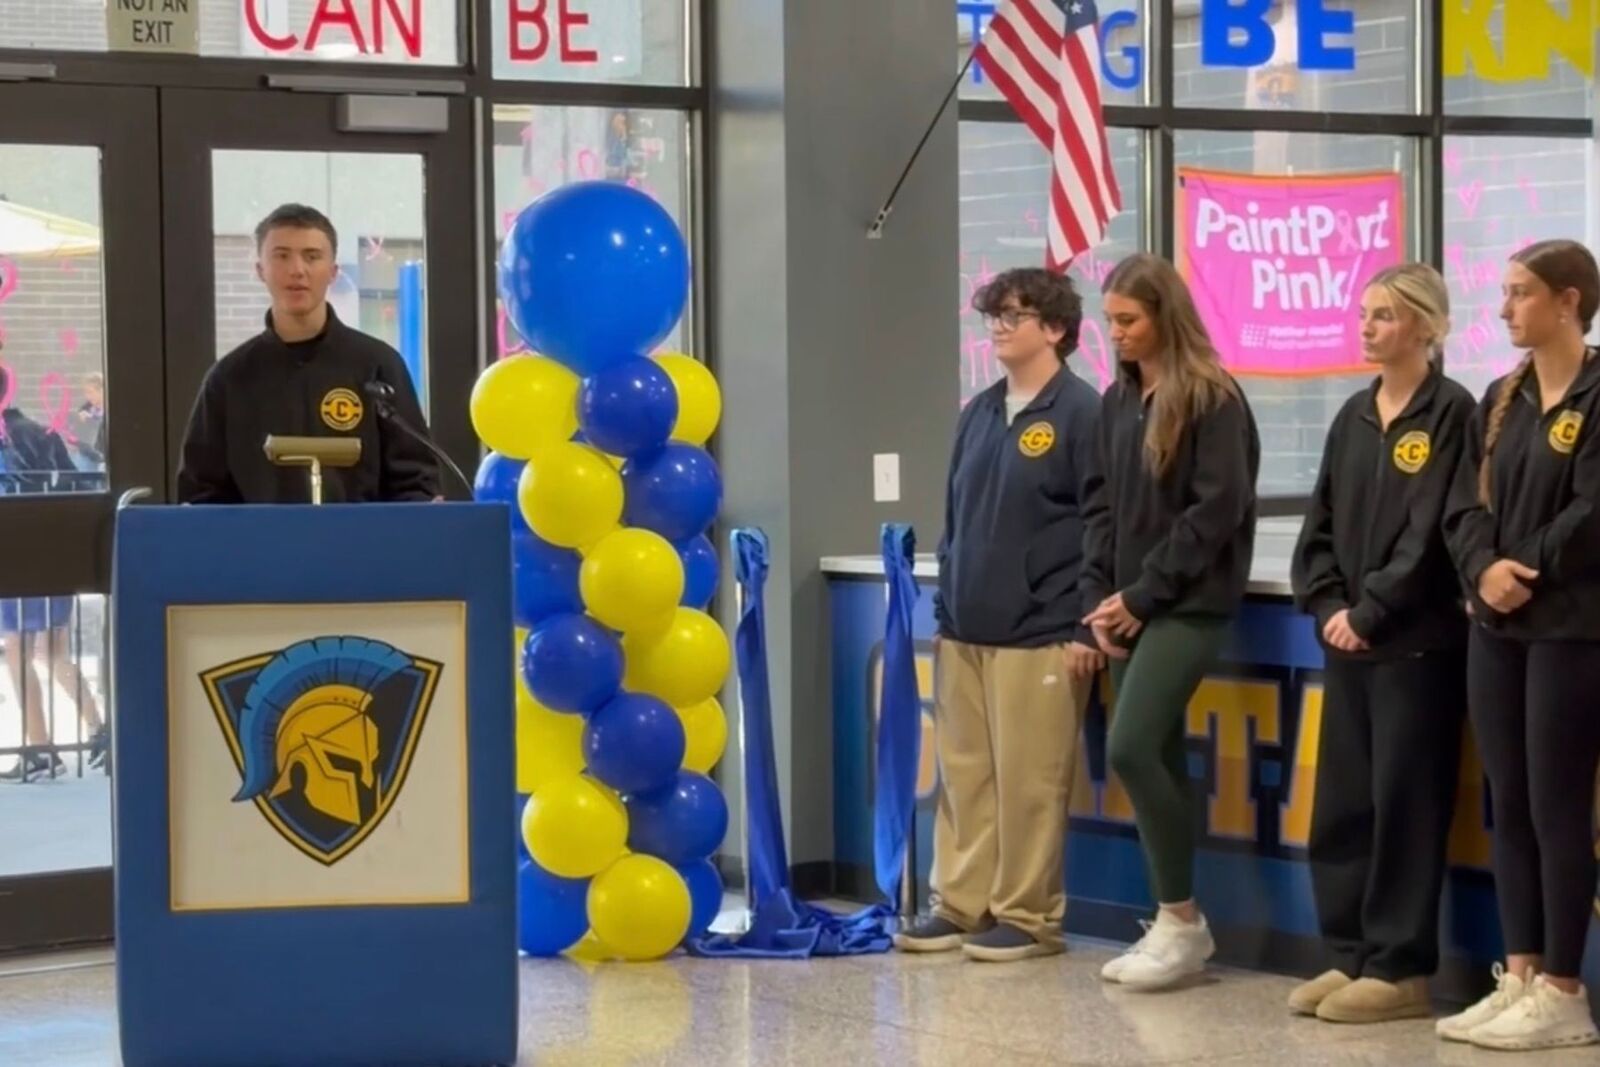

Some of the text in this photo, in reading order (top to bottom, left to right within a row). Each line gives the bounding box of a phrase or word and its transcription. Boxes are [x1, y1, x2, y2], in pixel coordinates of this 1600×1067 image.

[132, 20, 173, 43] EXIT
[244, 0, 599, 62] CAN BE
[1201, 0, 1356, 70] BE
